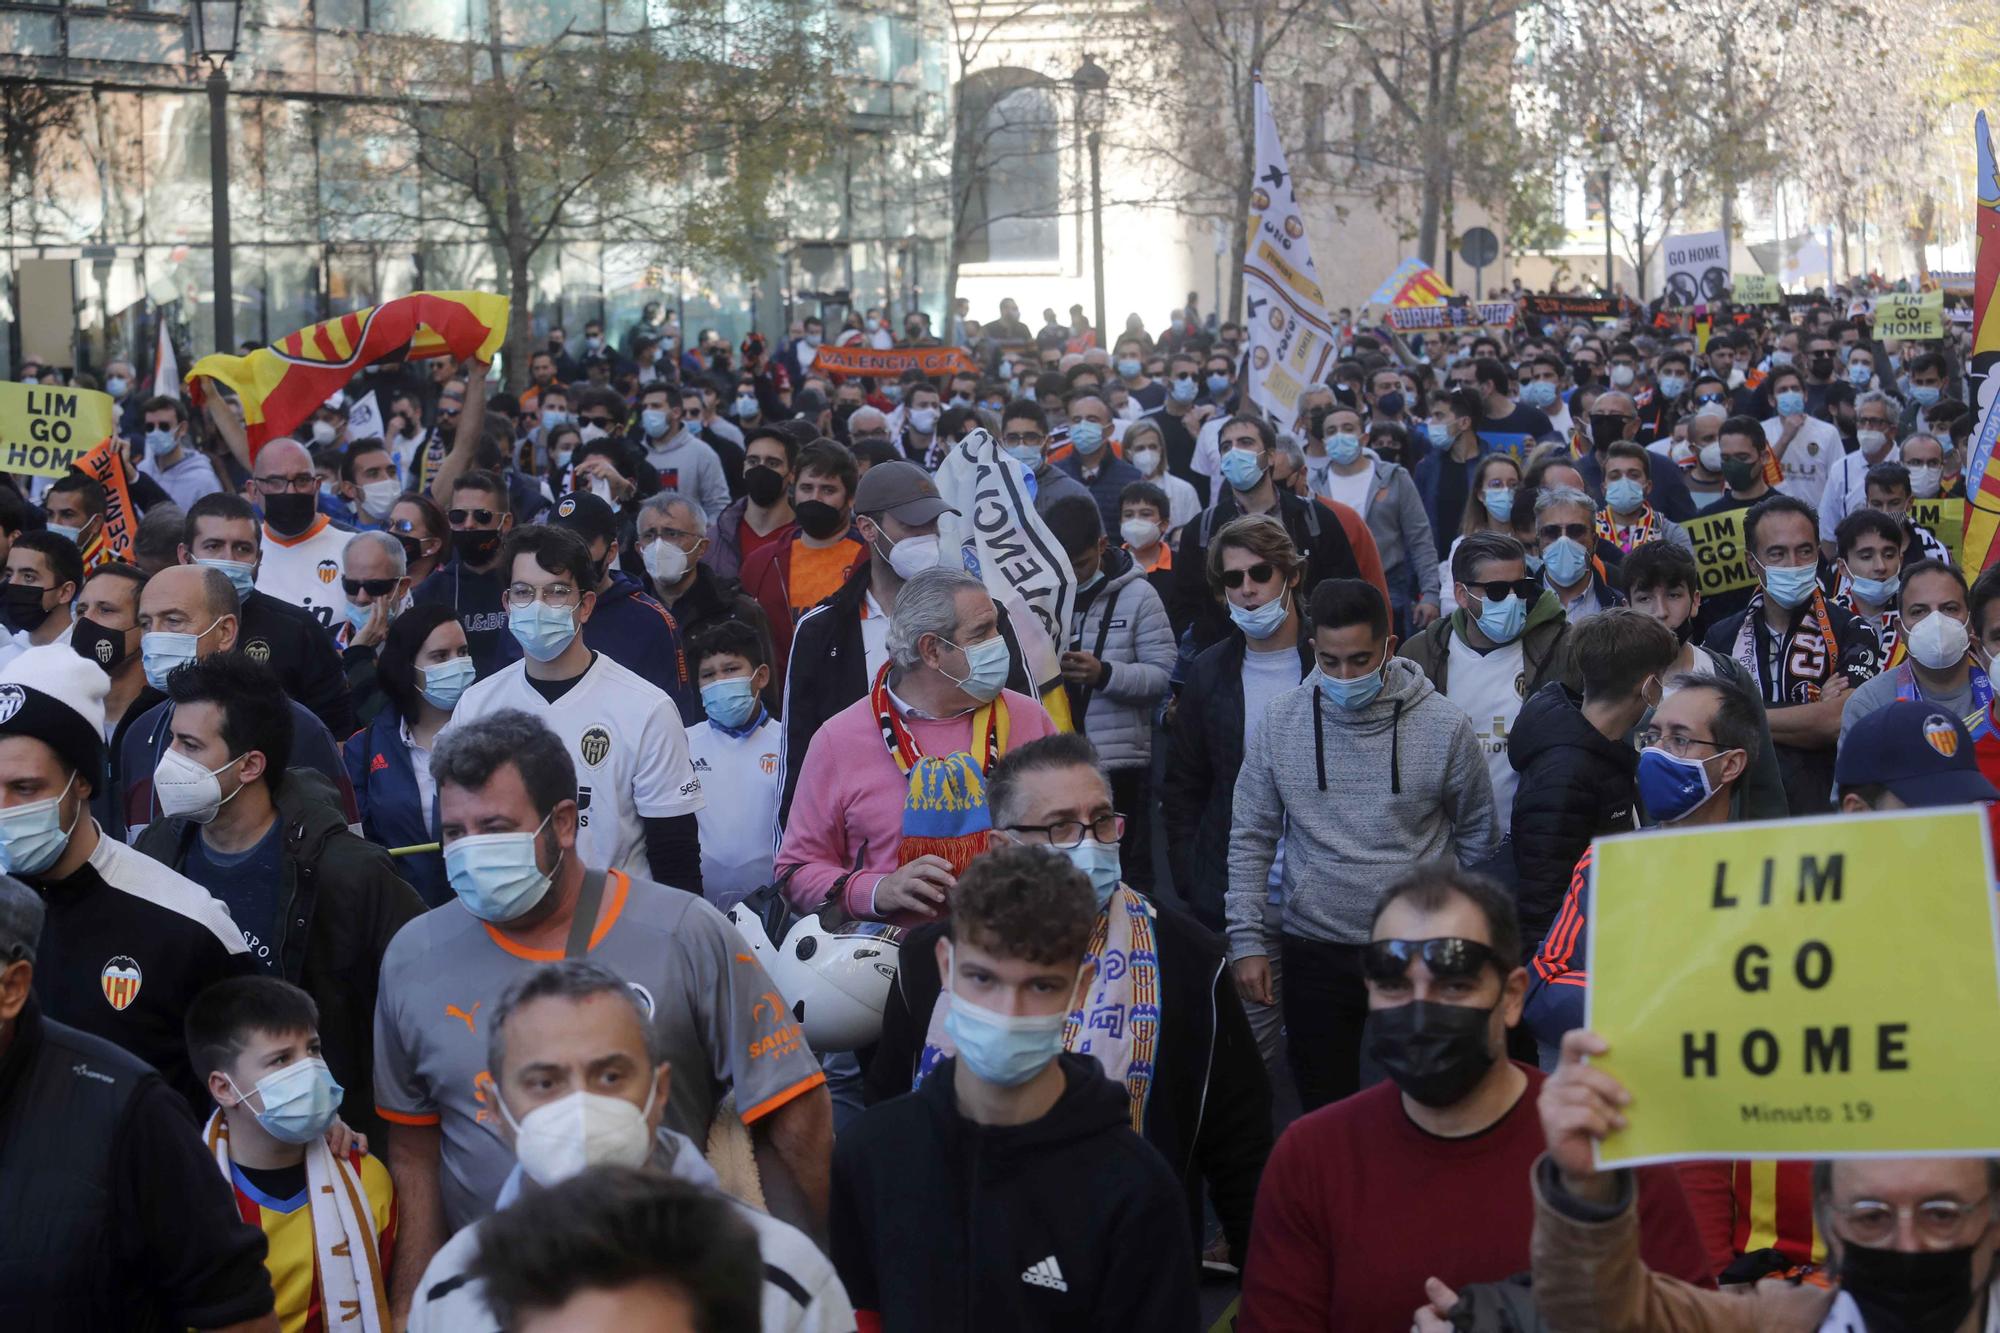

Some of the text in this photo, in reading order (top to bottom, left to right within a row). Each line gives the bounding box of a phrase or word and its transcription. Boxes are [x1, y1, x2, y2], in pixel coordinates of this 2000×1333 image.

[1668, 245, 1720, 266] GO HOME
[1738, 291, 1771, 300] HOME
[1893, 296, 1923, 306] LIM
[1392, 307, 1444, 328] CURVA
[1895, 307, 1920, 320] GO
[1882, 321, 1933, 335] HOME
[819, 351, 921, 370] VALENCIA
[27, 390, 78, 419] LIM
[30, 418, 73, 444] GO
[8, 443, 87, 473] HOM
[91, 450, 130, 552] SEMPRE
[1911, 505, 1940, 524] IM
[1688, 517, 1736, 545] LIM
[1697, 541, 1737, 566] GO
[1711, 853, 1845, 909] LIM
[1734, 940, 1834, 993] GO
[1682, 1023, 1909, 1079] HOME
[1740, 1102, 1874, 1124] Minuto 19
[1021, 1272, 1068, 1292] adidas
